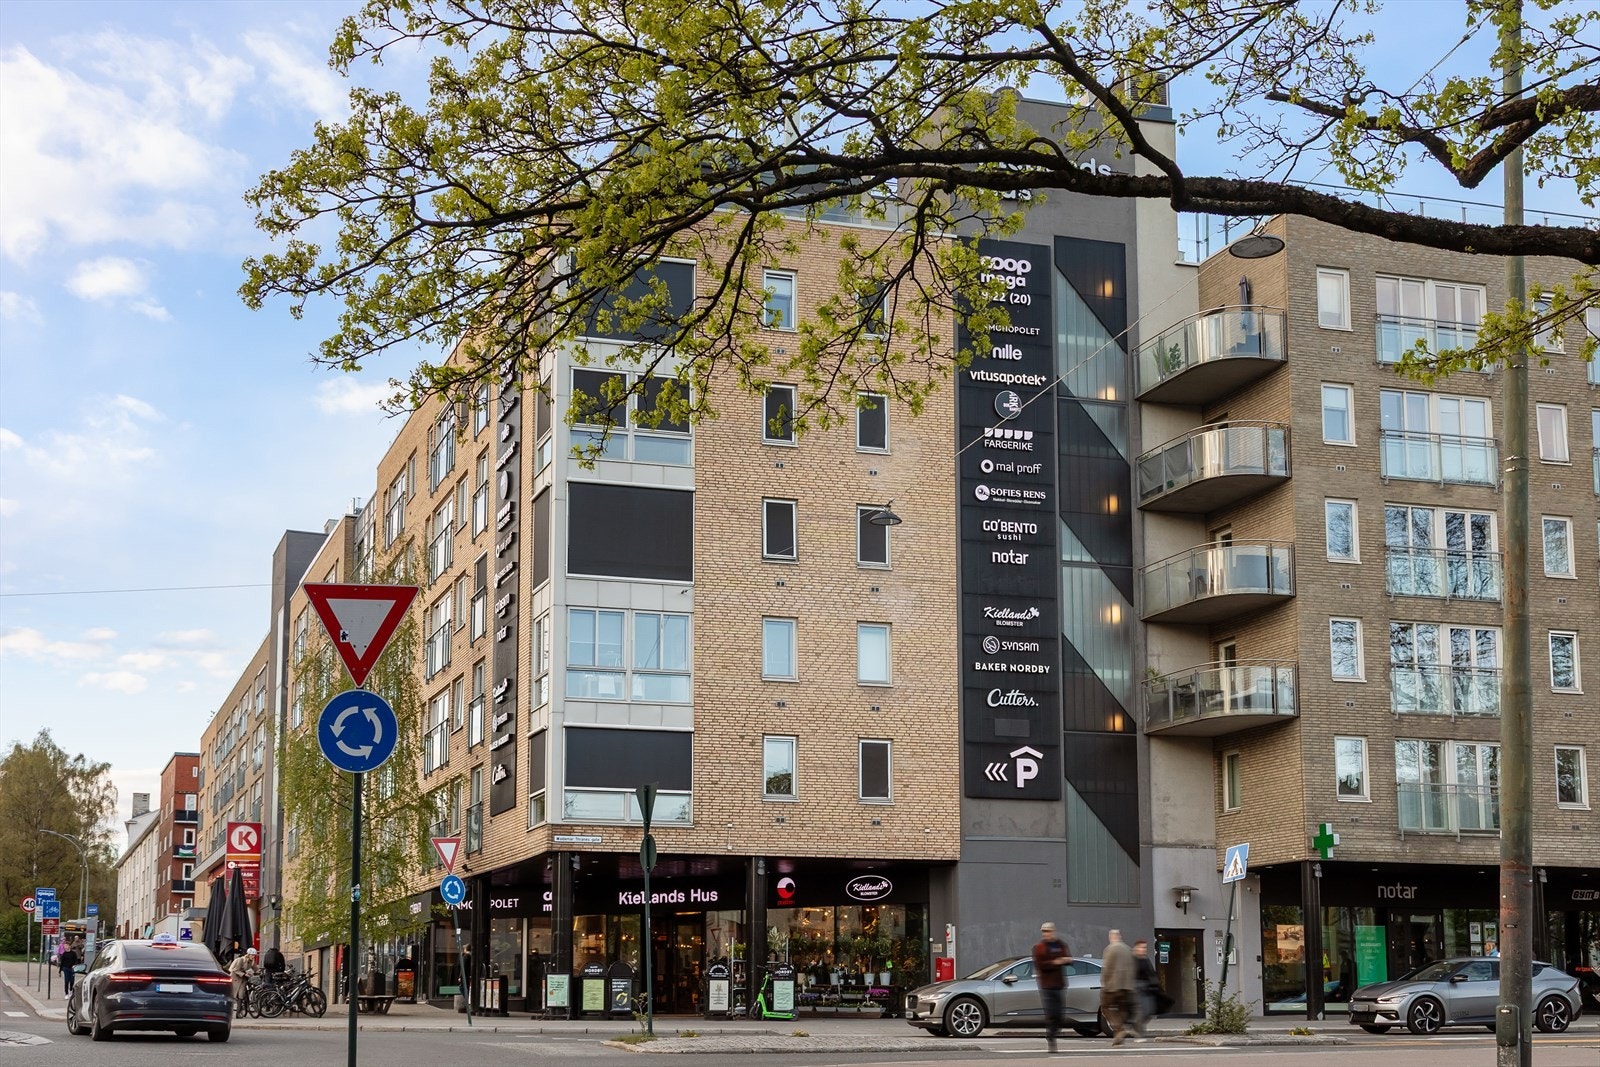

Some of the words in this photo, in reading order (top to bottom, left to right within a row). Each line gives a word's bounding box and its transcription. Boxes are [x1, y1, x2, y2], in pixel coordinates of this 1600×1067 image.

[1009, 293, 1031, 306] (20)
[992, 345, 1023, 361] nille
[984, 438, 1033, 451] FARGERIKE
[996, 461, 1015, 473] mal
[1016, 462, 1042, 475] proff
[990, 487, 1022, 498] SOFIES
[1023, 490, 1046, 500] RENS
[997, 533, 1022, 541] sushi
[991, 549, 1030, 565] notar
[983, 606, 1032, 620] Kiellands
[1001, 641, 1040, 652] SYNSAM
[975, 661, 1007, 672] BAKER
[1009, 663, 1050, 674] NORDBY
[1016, 758, 1039, 788] P
[238, 831, 254, 849] K
[690, 888, 718, 902] Hus
[1377, 882, 1418, 899] notar
[23, 900, 35, 909] 40
